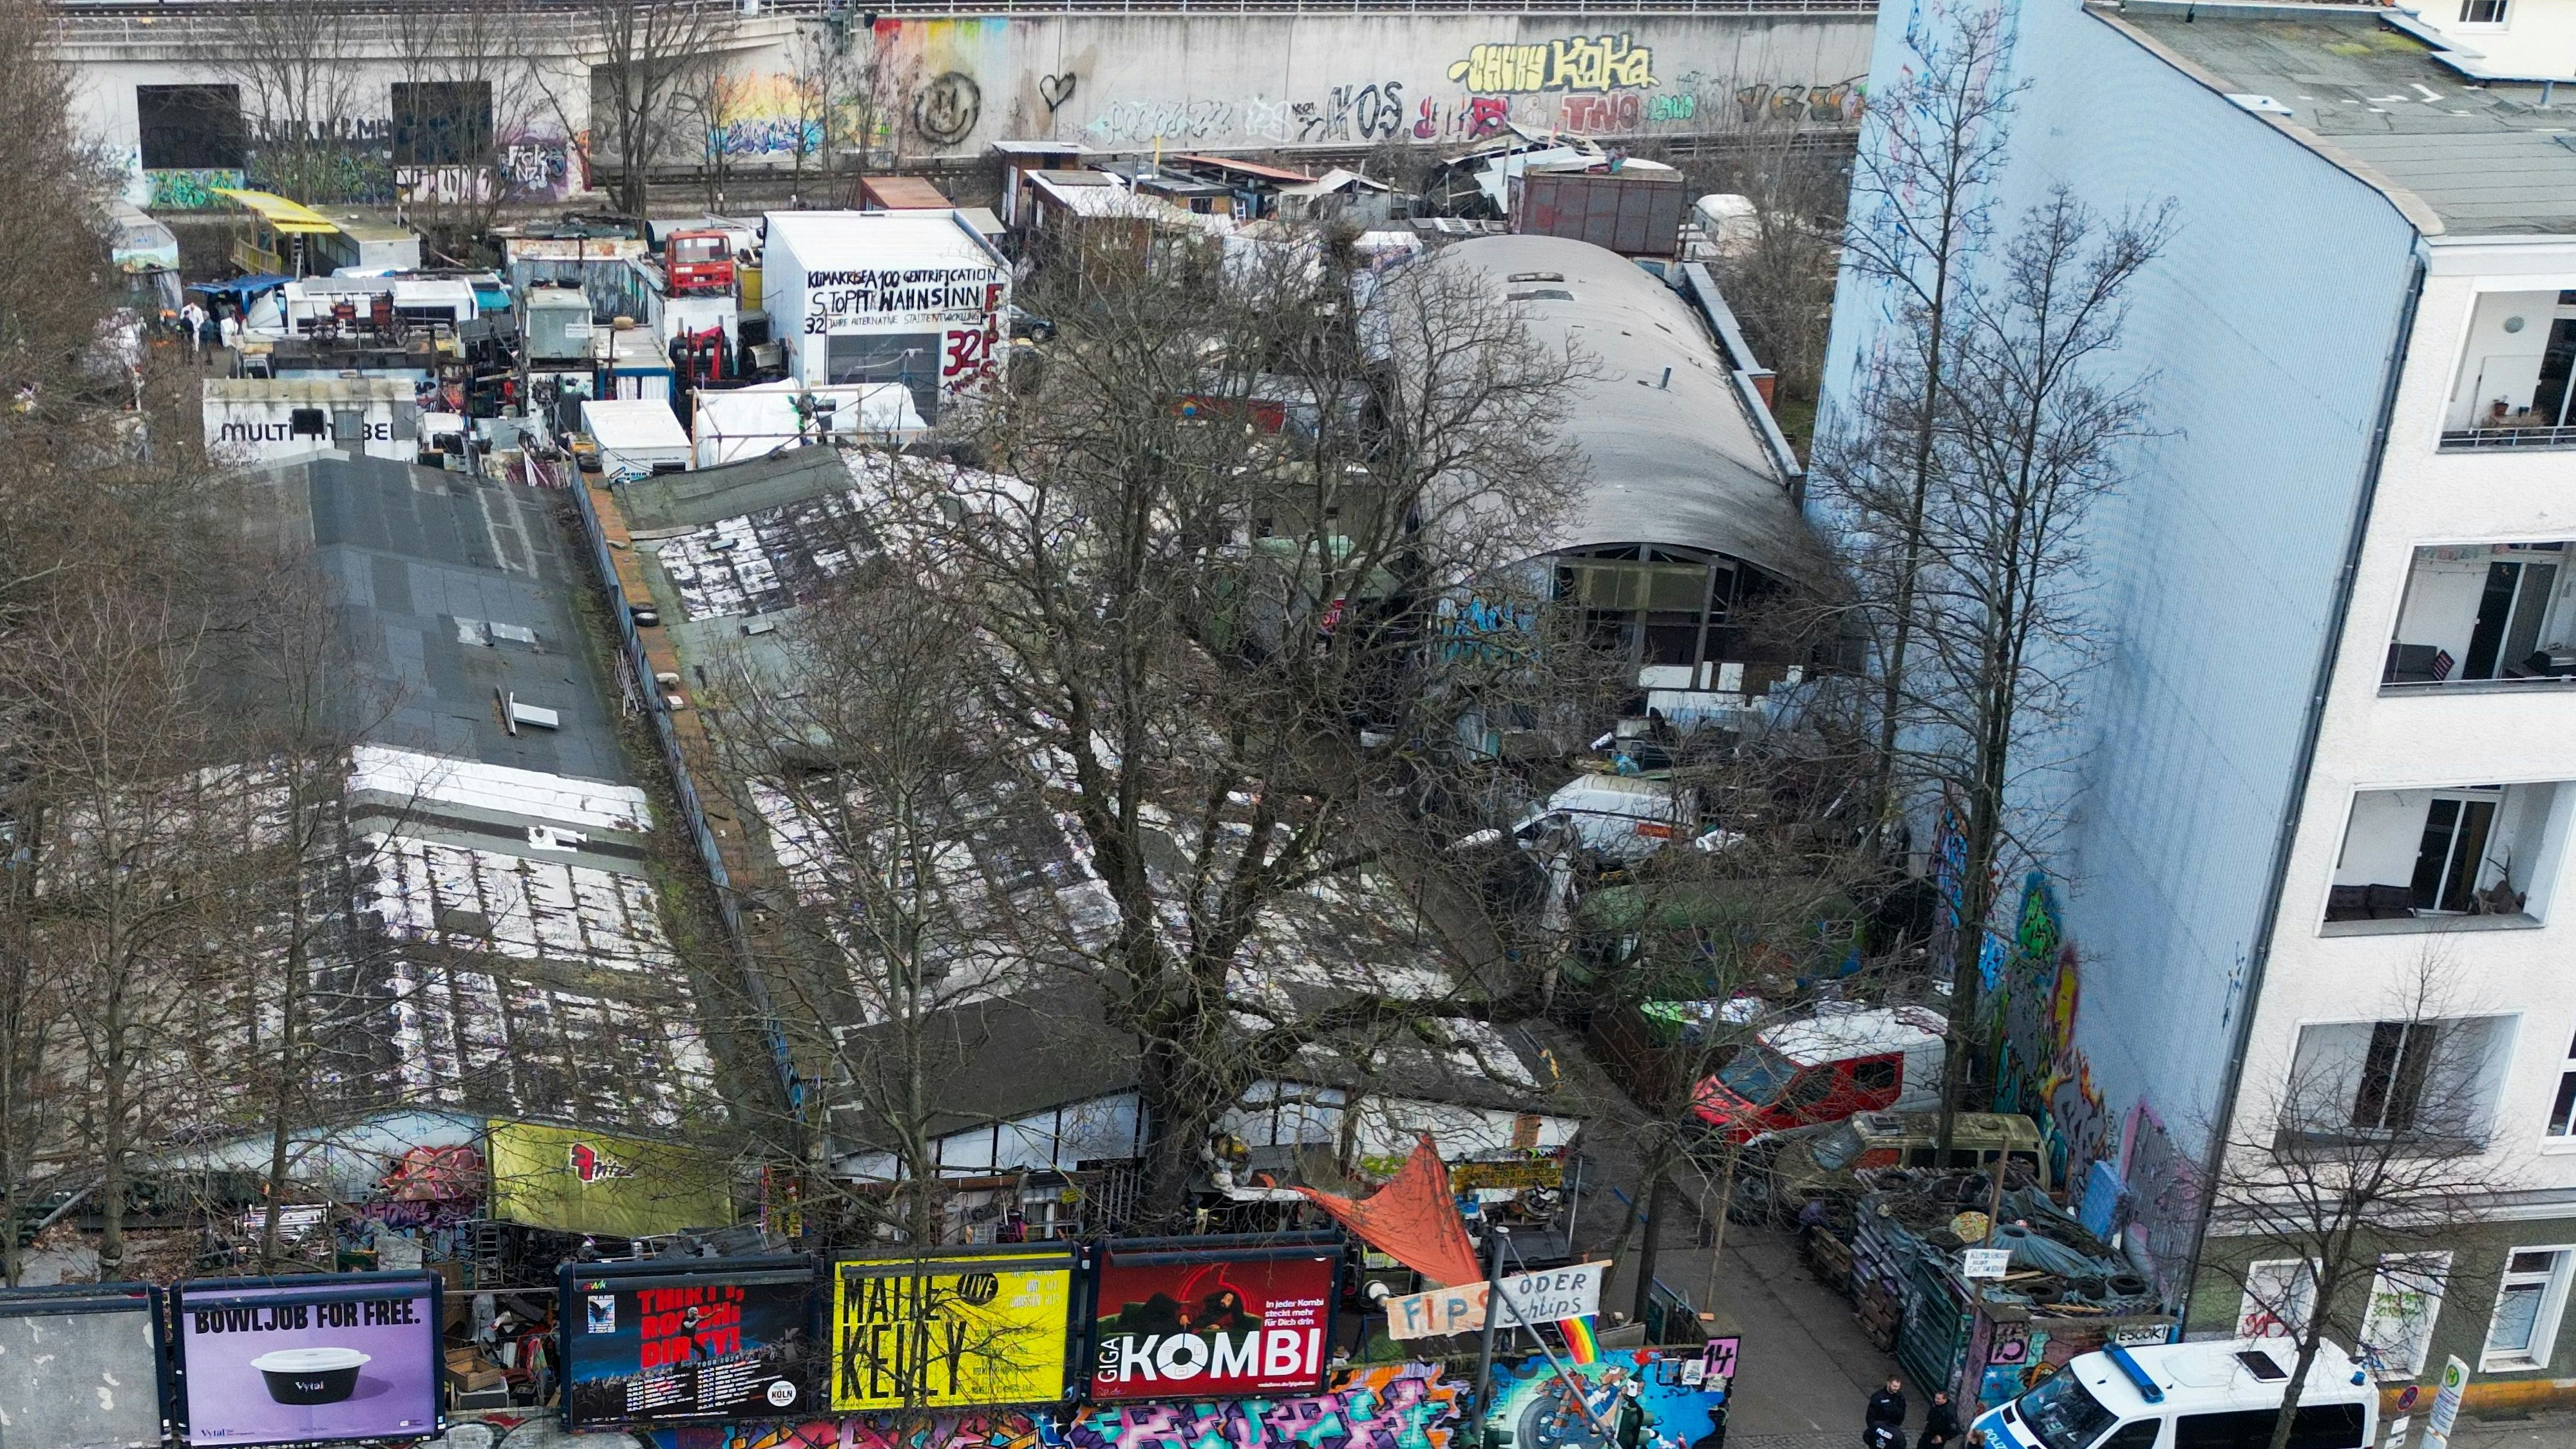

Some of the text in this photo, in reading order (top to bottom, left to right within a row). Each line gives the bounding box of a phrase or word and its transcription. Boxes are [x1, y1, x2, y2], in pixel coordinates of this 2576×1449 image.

[804, 317, 825, 334] 32
[943, 329, 981, 375] 32
[1520, 1273, 1587, 1294] ODER
[317, 1303, 357, 1328] FOR
[364, 1298, 421, 1326] FREE.
[1097, 1337, 1120, 1383] GIGA
[1119, 1328, 1321, 1382] KOMBI
[1704, 1344, 1734, 1374] 14
[295, 1381, 324, 1392] Vytal
[201, 1428, 225, 1438] Vytal
